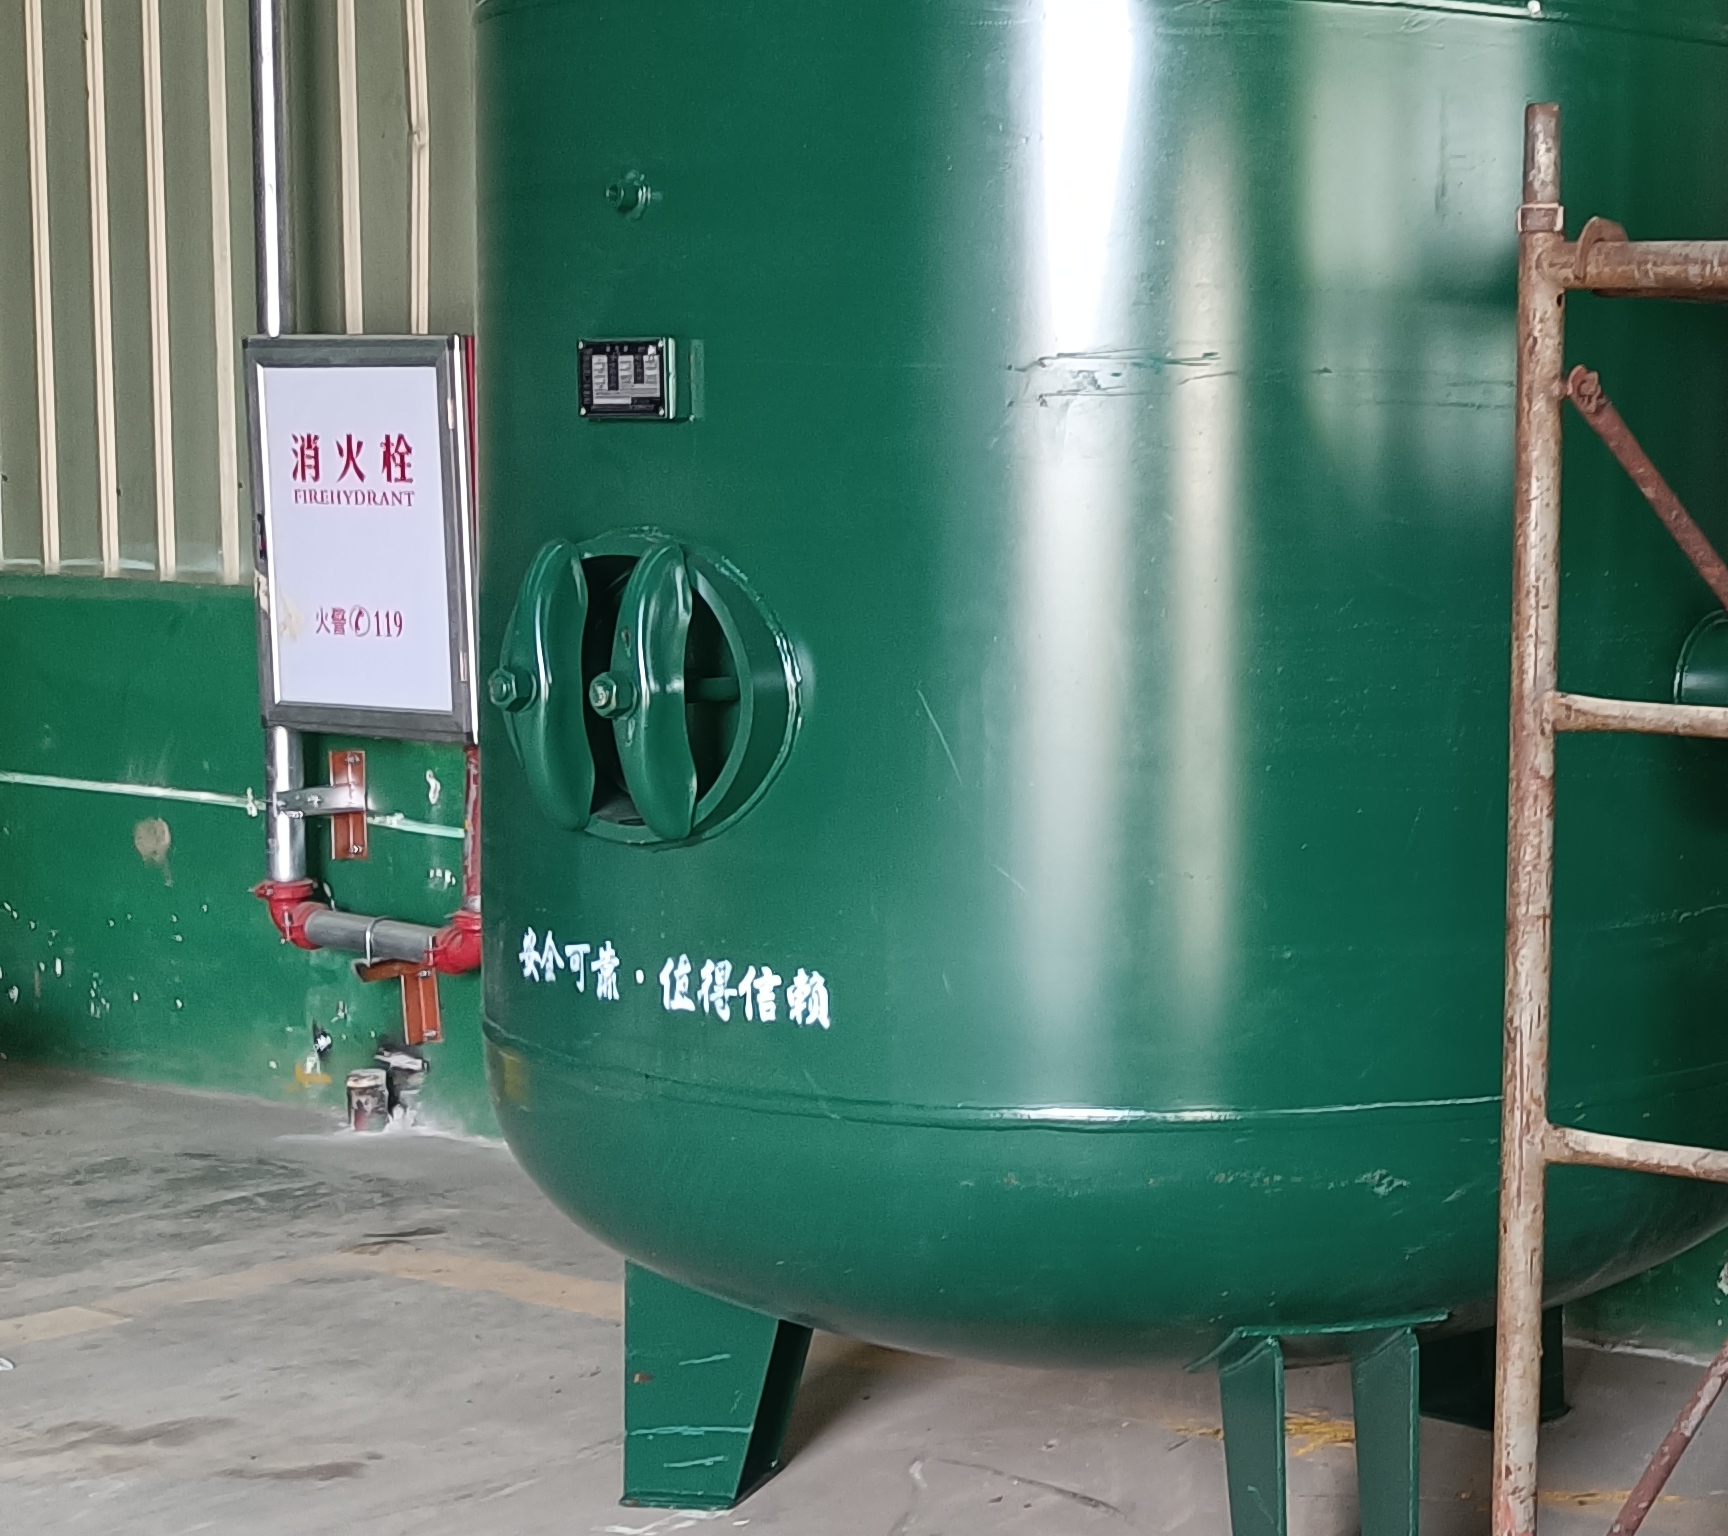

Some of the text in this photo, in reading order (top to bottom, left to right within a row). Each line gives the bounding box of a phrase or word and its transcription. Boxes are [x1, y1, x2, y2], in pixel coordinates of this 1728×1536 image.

[291, 433, 414, 483] 消火栓
[294, 488, 415, 507] FIREHYDRANT
[374, 610, 403, 638] 119
